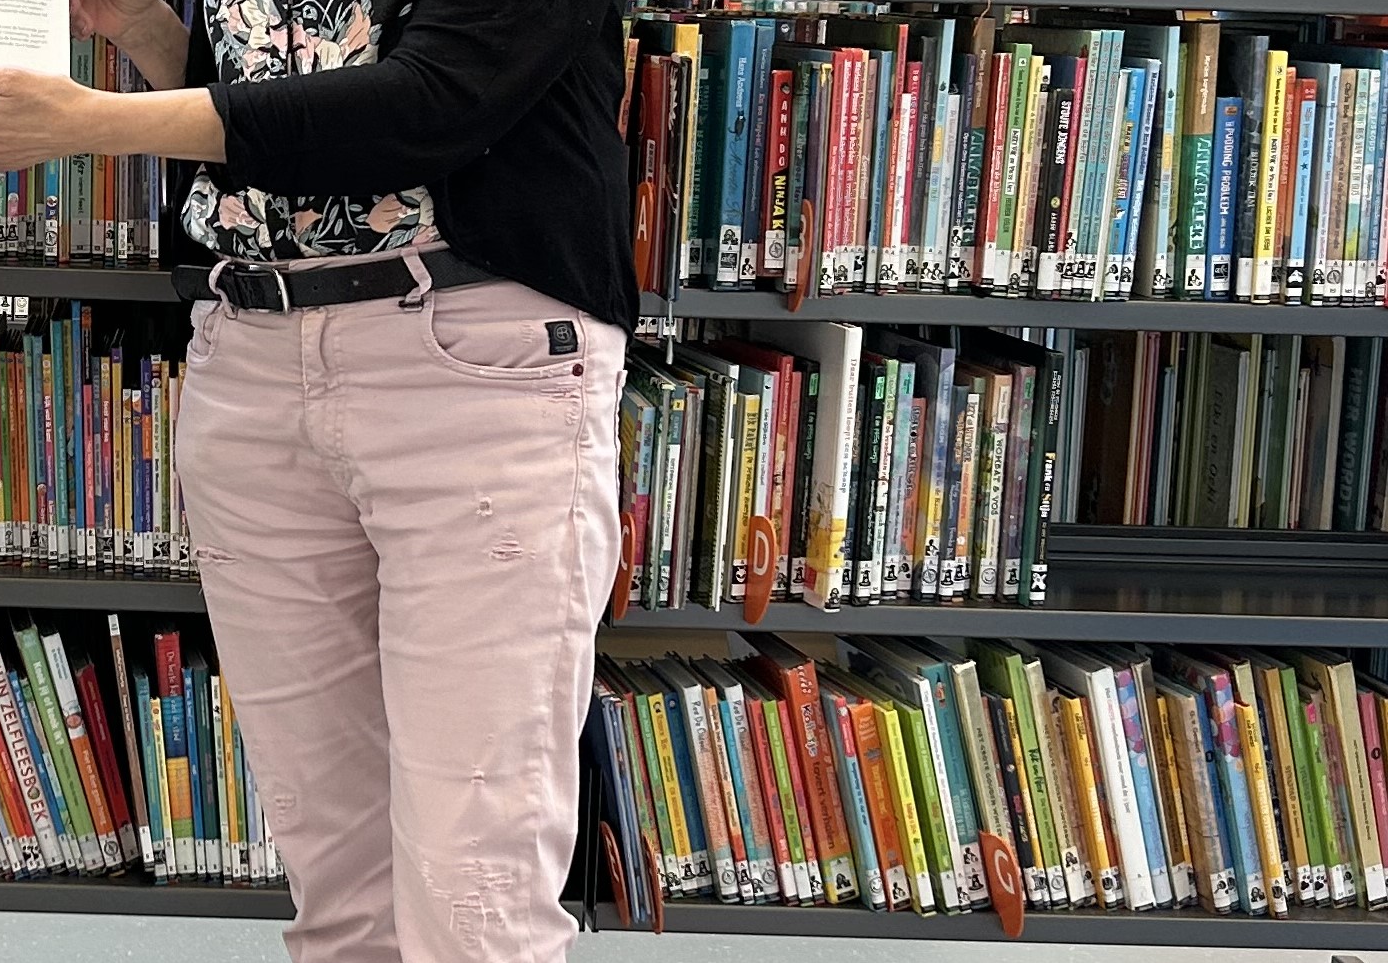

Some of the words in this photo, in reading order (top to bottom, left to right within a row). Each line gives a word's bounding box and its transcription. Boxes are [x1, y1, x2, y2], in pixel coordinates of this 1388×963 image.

[1058, 101, 1072, 130] STOUTE
[1055, 131, 1069, 164] JONGENS
[1222, 129, 1233, 166] PUDDING
[773, 176, 786, 216] NINJA
[963, 131, 984, 244] ANNABELLEKE
[1194, 137, 1210, 248] ANNABELLEKE
[1220, 170, 1231, 214] PROBLEEM
[637, 195, 648, 242] A
[849, 359, 857, 382] Daar
[846, 384, 855, 413] buiten
[1345, 367, 1363, 421] HIER
[844, 417, 853, 440] loopt
[993, 439, 1004, 483] WOMBAT
[1044, 453, 1056, 482] Frank
[1338, 432, 1356, 516] WORDT
[991, 496, 999, 516] VOS
[753, 529, 769, 576] D
[33, 661, 47, 685] Kook
[1, 704, 47, 820] ZELFLEESBOEK
[814, 761, 826, 796] tovert
[821, 798, 835, 849] verhalen
[994, 849, 1015, 894] G
